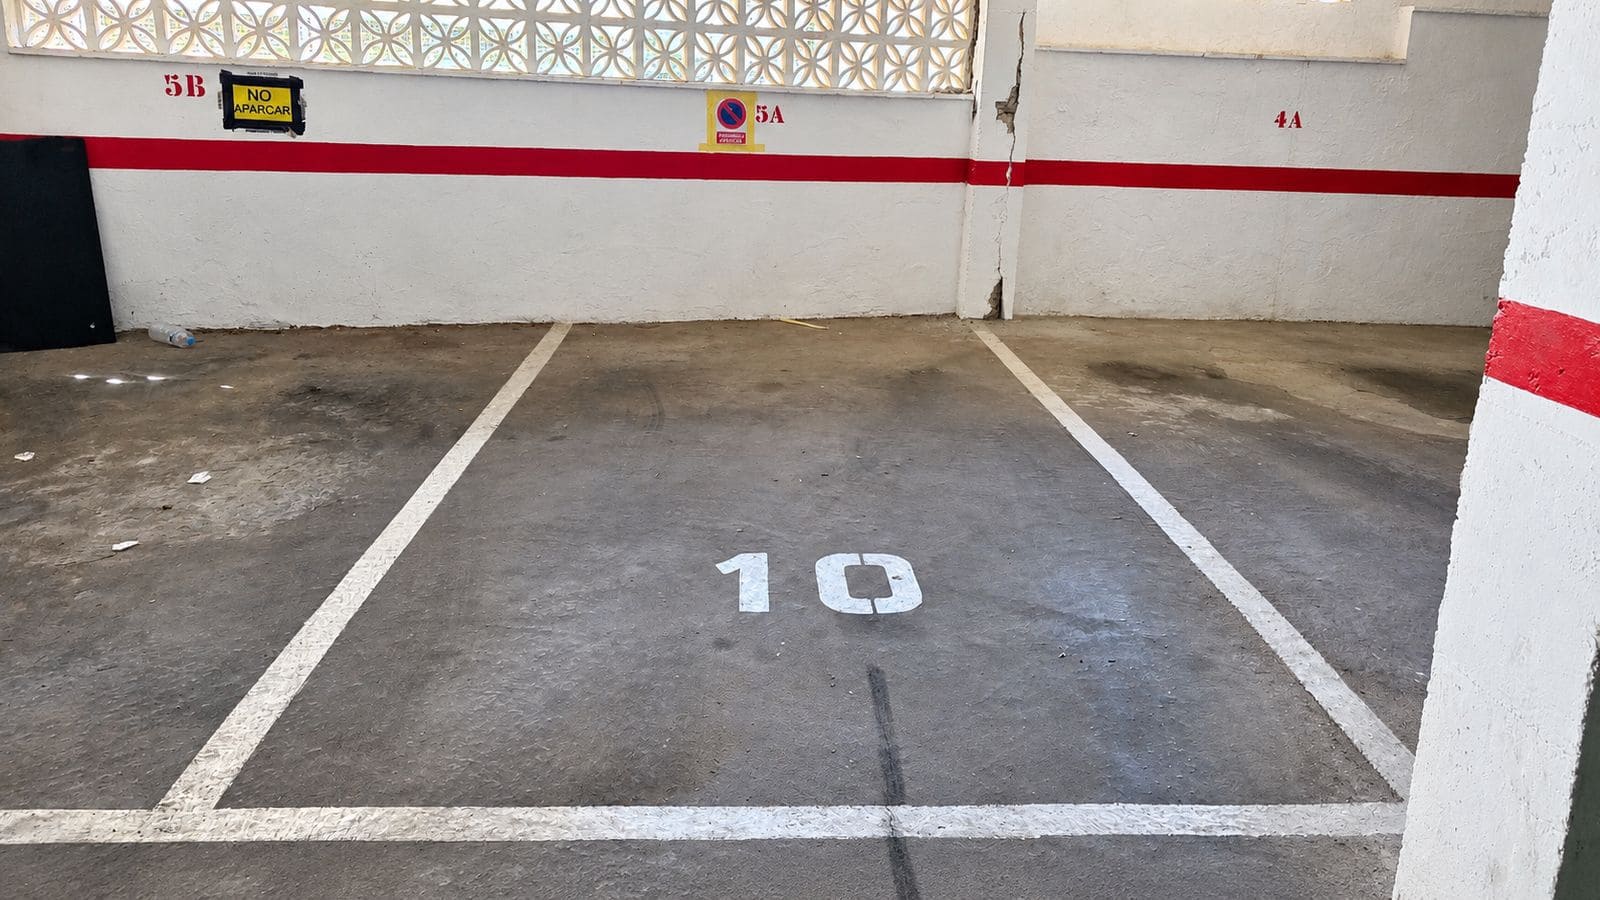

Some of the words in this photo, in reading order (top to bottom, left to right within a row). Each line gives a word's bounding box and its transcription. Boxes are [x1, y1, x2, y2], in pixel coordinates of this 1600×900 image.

[164, 73, 206, 97] 5B
[247, 88, 272, 102] NO
[234, 103, 291, 116] APARCAR
[755, 104, 785, 124] 5A
[1274, 110, 1302, 128] 4A
[715, 552, 923, 615] 10
